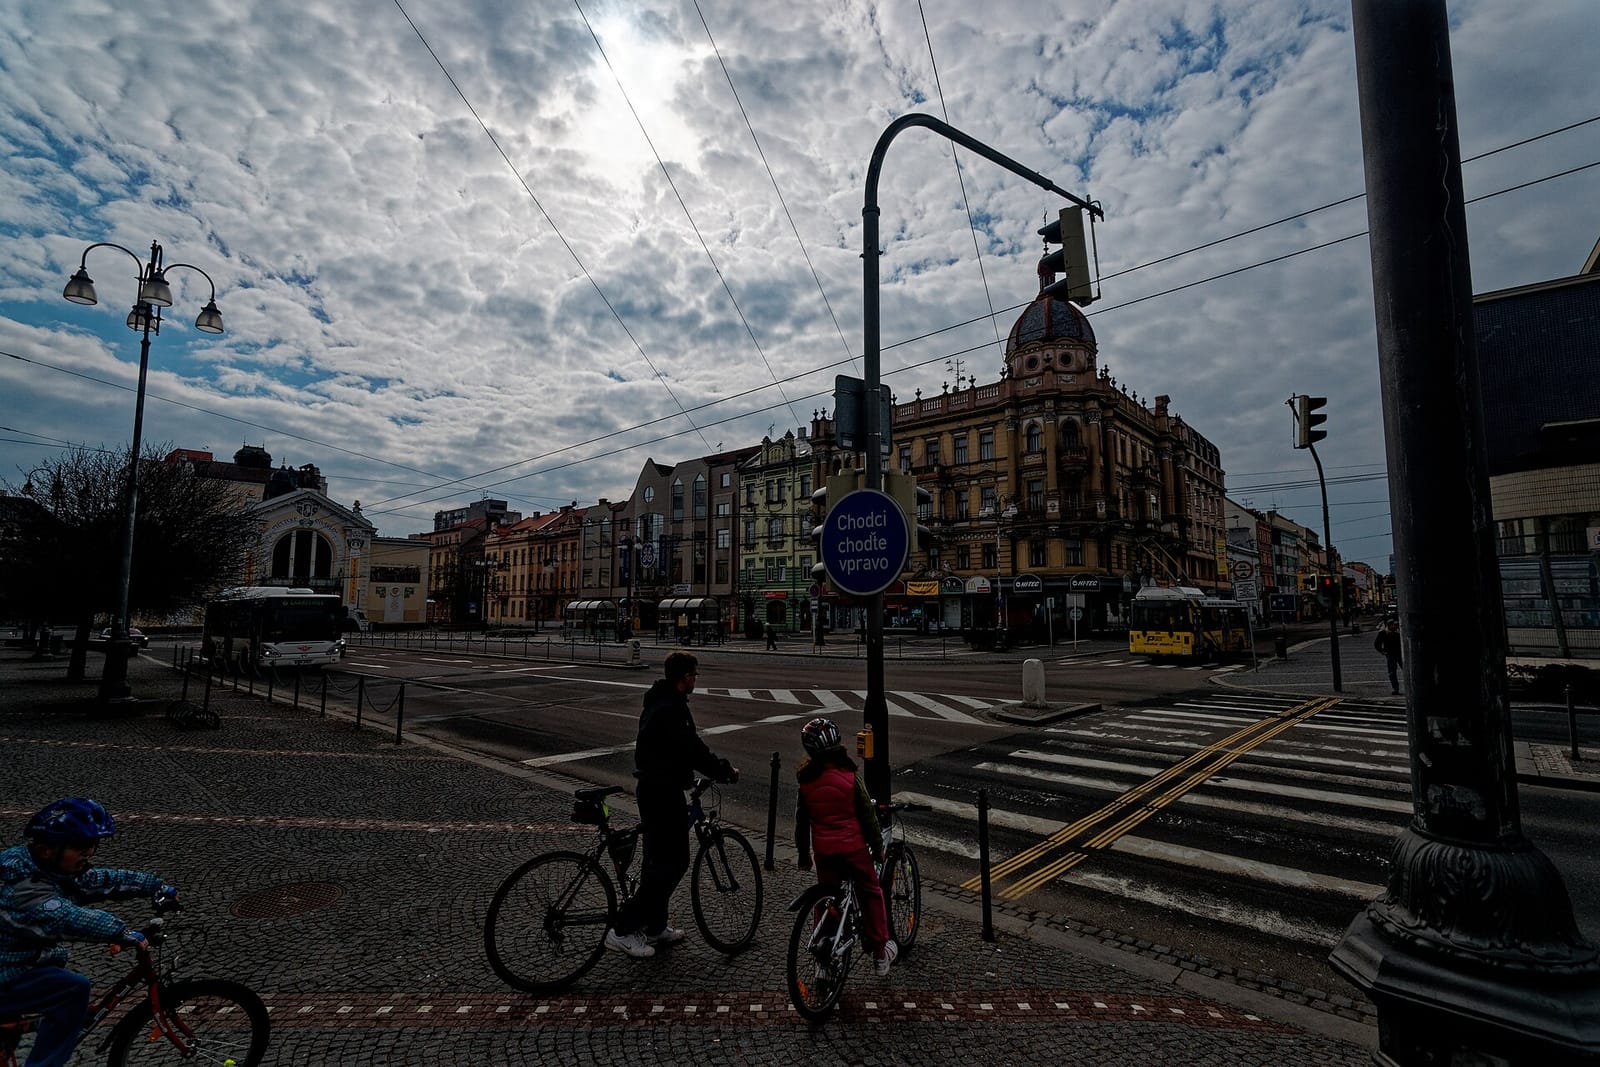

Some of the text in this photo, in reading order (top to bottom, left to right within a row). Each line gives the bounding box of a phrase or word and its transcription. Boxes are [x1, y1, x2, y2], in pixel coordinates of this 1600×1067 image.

[837, 509, 887, 530] Chodci
[838, 531, 887, 554] choďte
[838, 557, 889, 575] vpravo
